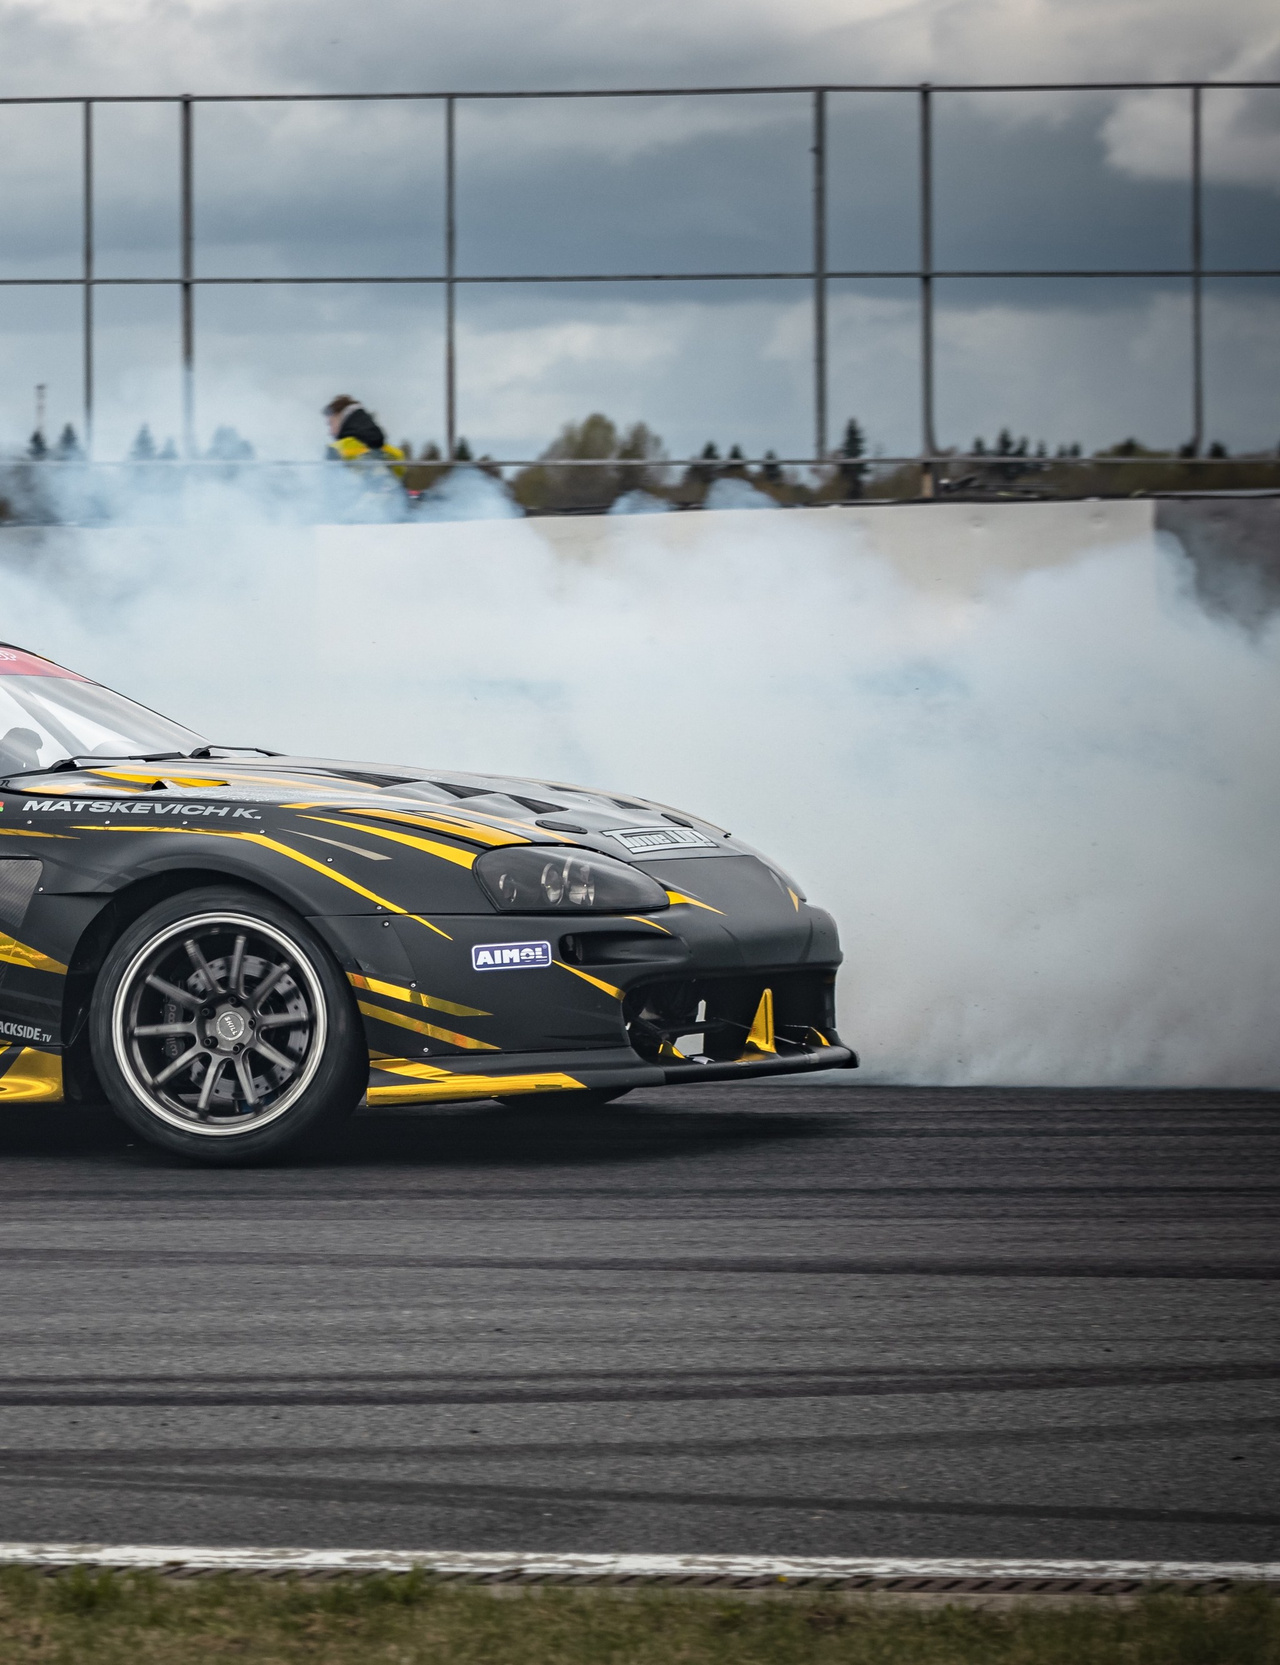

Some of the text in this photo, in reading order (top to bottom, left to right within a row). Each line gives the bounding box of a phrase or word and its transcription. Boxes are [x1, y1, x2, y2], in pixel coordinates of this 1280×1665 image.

[22, 800, 262, 820] MATSKEVICH K.
[475, 947, 547, 966] AIMOL
[223, 1016, 239, 1036] SKILL
